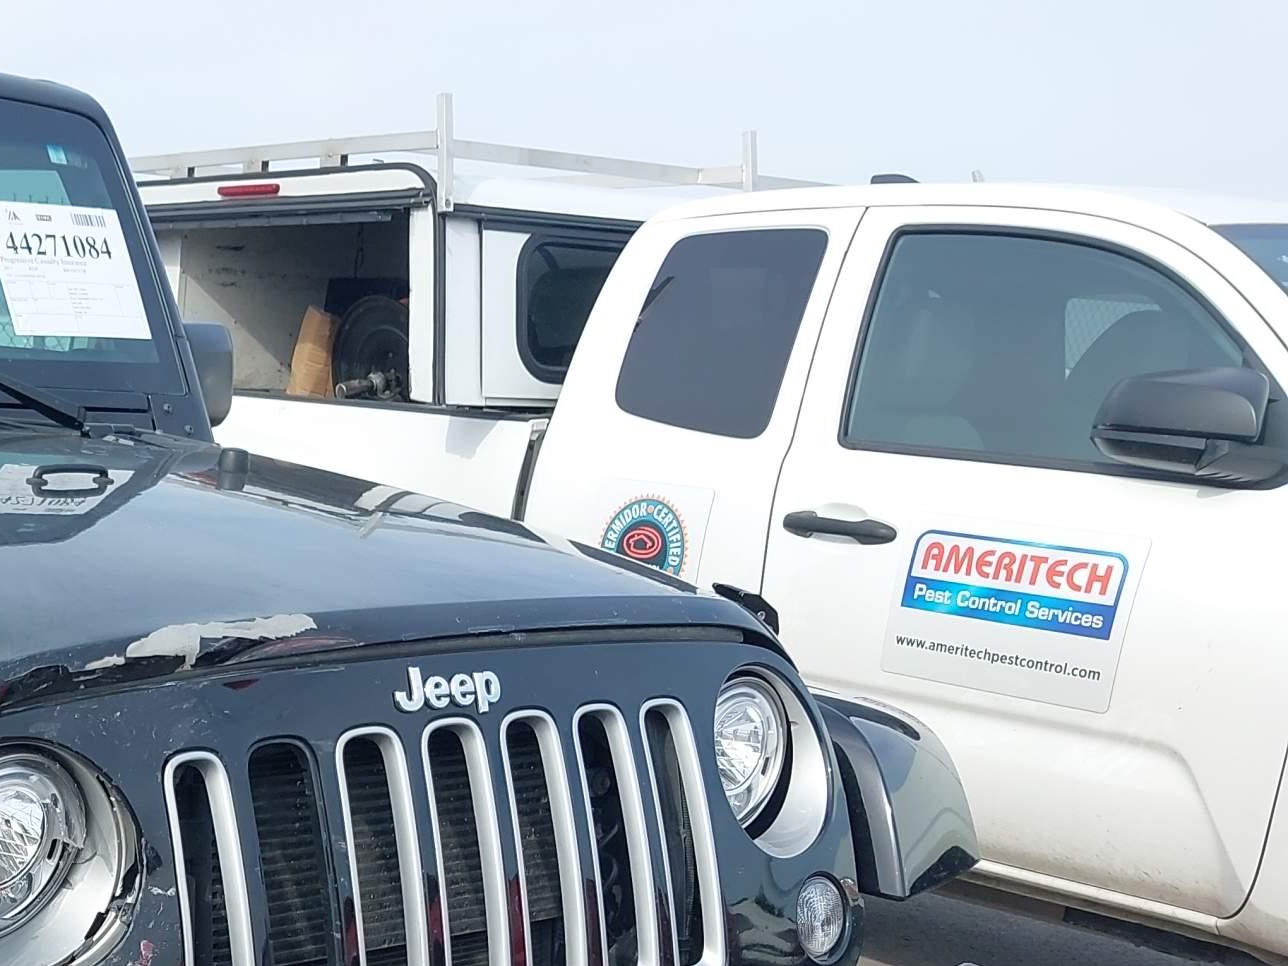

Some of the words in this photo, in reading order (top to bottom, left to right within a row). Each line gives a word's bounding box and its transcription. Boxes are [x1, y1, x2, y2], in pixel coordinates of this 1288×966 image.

[5, 231, 112, 259] 44271084
[653, 504, 681, 567] CERTIFIED
[921, 541, 1115, 596] AMERITECH
[913, 583, 952, 605] Pest
[956, 590, 1022, 615] Control
[1025, 601, 1104, 629] Services
[895, 634, 1102, 681] www.ameritechpestcontrol.com
[393, 666, 501, 713] Jeep
